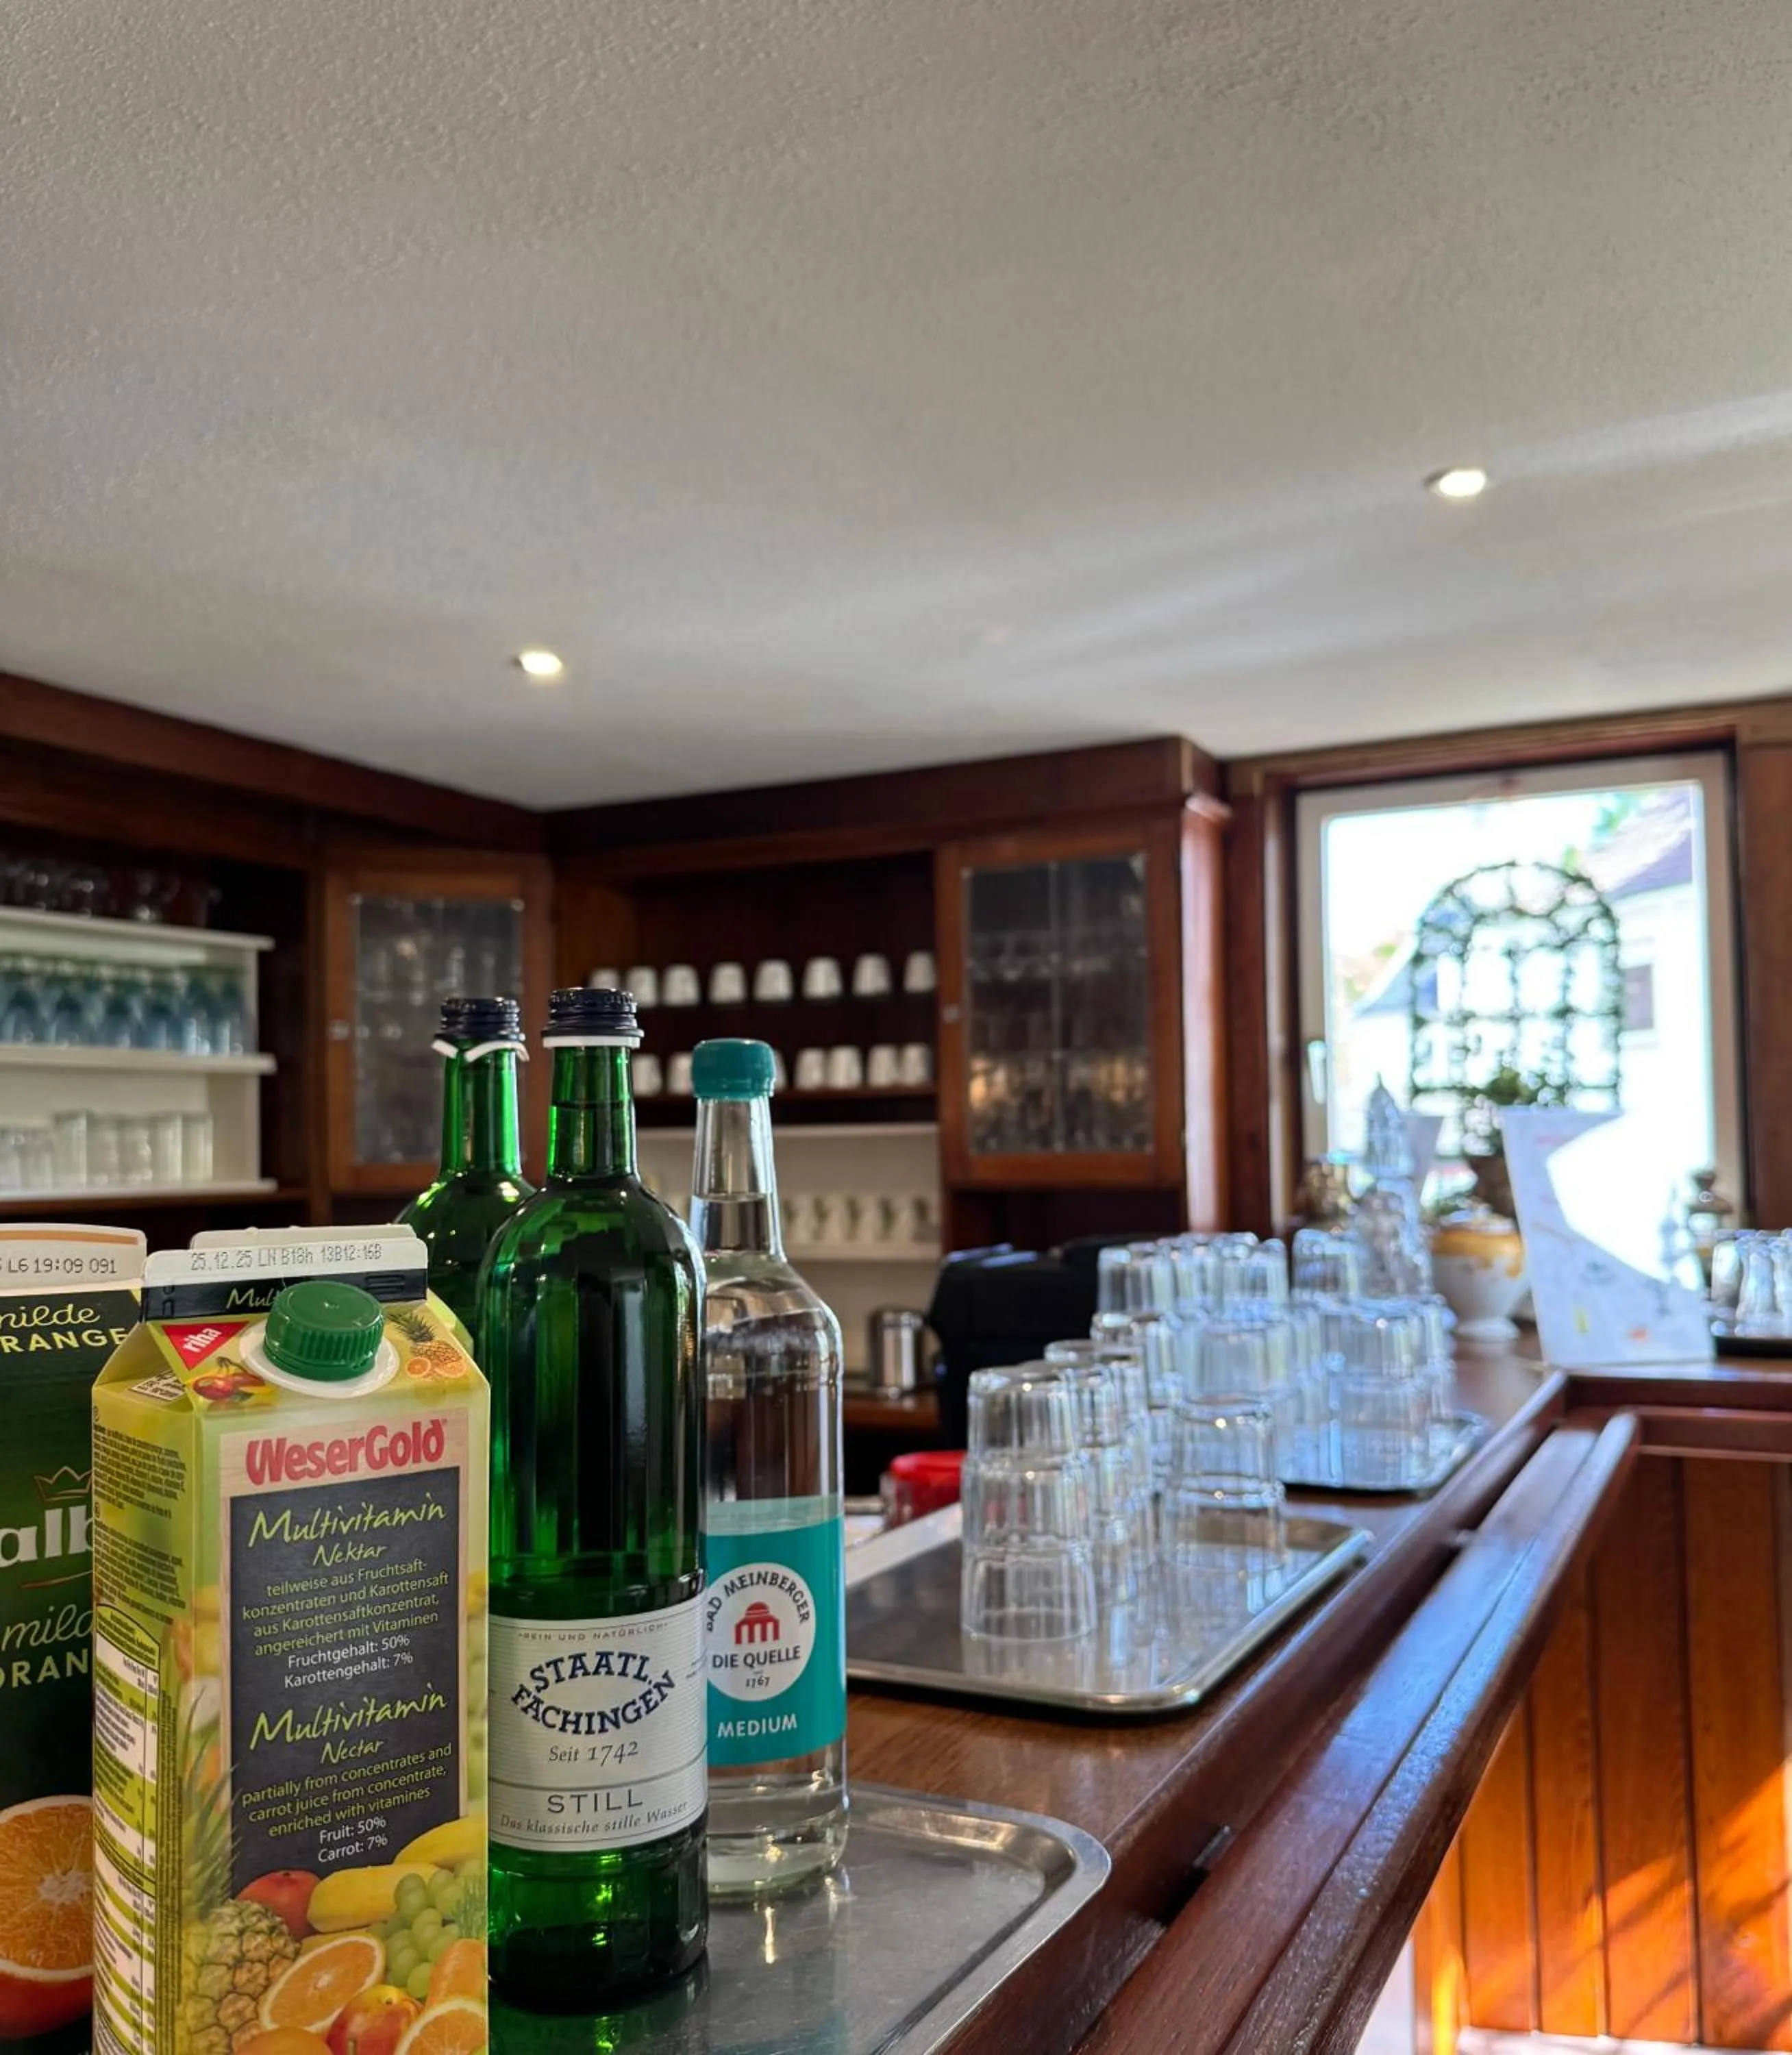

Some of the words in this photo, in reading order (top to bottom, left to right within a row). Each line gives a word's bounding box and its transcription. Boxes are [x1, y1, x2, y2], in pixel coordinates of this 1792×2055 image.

[8, 1259, 29, 1273] L6
[34, 1258, 83, 1273] 19:09
[89, 1258, 117, 1273] 091
[182, 1328, 222, 1353] riha
[246, 1418, 445, 1486] WeserGold
[247, 1492, 446, 1547] Multivitamin
[313, 1542, 388, 1567] Nektar
[242, 1593, 336, 1620] konzentraten
[340, 1586, 366, 1603] und
[369, 1572, 449, 1597] Karottensaft
[266, 1577, 327, 1597] teilweise
[332, 1573, 354, 1587] aus
[358, 1559, 427, 1582] Fruchtsaft-
[723, 1571, 810, 1624] MEINBERGER
[253, 1622, 279, 1637] aus
[255, 1632, 344, 1656] angereichert
[348, 1624, 370, 1639] mit
[373, 1612, 438, 1634] Vitaminen
[288, 1641, 378, 1669] Fruchtgehalt:
[381, 1634, 410, 1652] 50%
[712, 1654, 739, 1669] DIE
[743, 1645, 801, 1670] QUELLE
[284, 1657, 390, 1689] Karottengehalt:
[393, 1652, 413, 1667] 7%
[530, 1651, 652, 1693] STAATL.
[249, 1682, 446, 1750] Multivitamin
[511, 1670, 675, 1734] FACHINGEN
[717, 1713, 797, 1738] MEDIUM
[321, 1740, 384, 1764] Nectar
[549, 1746, 580, 1763] Seit
[588, 1741, 639, 1767] 1742
[242, 1781, 301, 1808] partially
[305, 1773, 338, 1790] from
[343, 1753, 425, 1782] concentrates
[428, 1743, 451, 1761] and
[249, 1803, 297, 1822] carrot
[296, 1795, 329, 1815] juice
[332, 1786, 364, 1804] from
[269, 1811, 332, 1837] enriched
[334, 1803, 365, 1821] with
[369, 1786, 431, 1812] vitamines
[547, 1789, 643, 1814] STILL
[319, 1826, 355, 1844] Fruit:
[358, 1816, 387, 1834] 50%
[500, 1814, 522, 1829] Das
[526, 1819, 599, 1838] klassische
[604, 1814, 640, 1832] stille
[647, 1802, 688, 1823] Wasser
[317, 1842, 364, 1863] Carrot:
[366, 1836, 388, 1850] 7%
